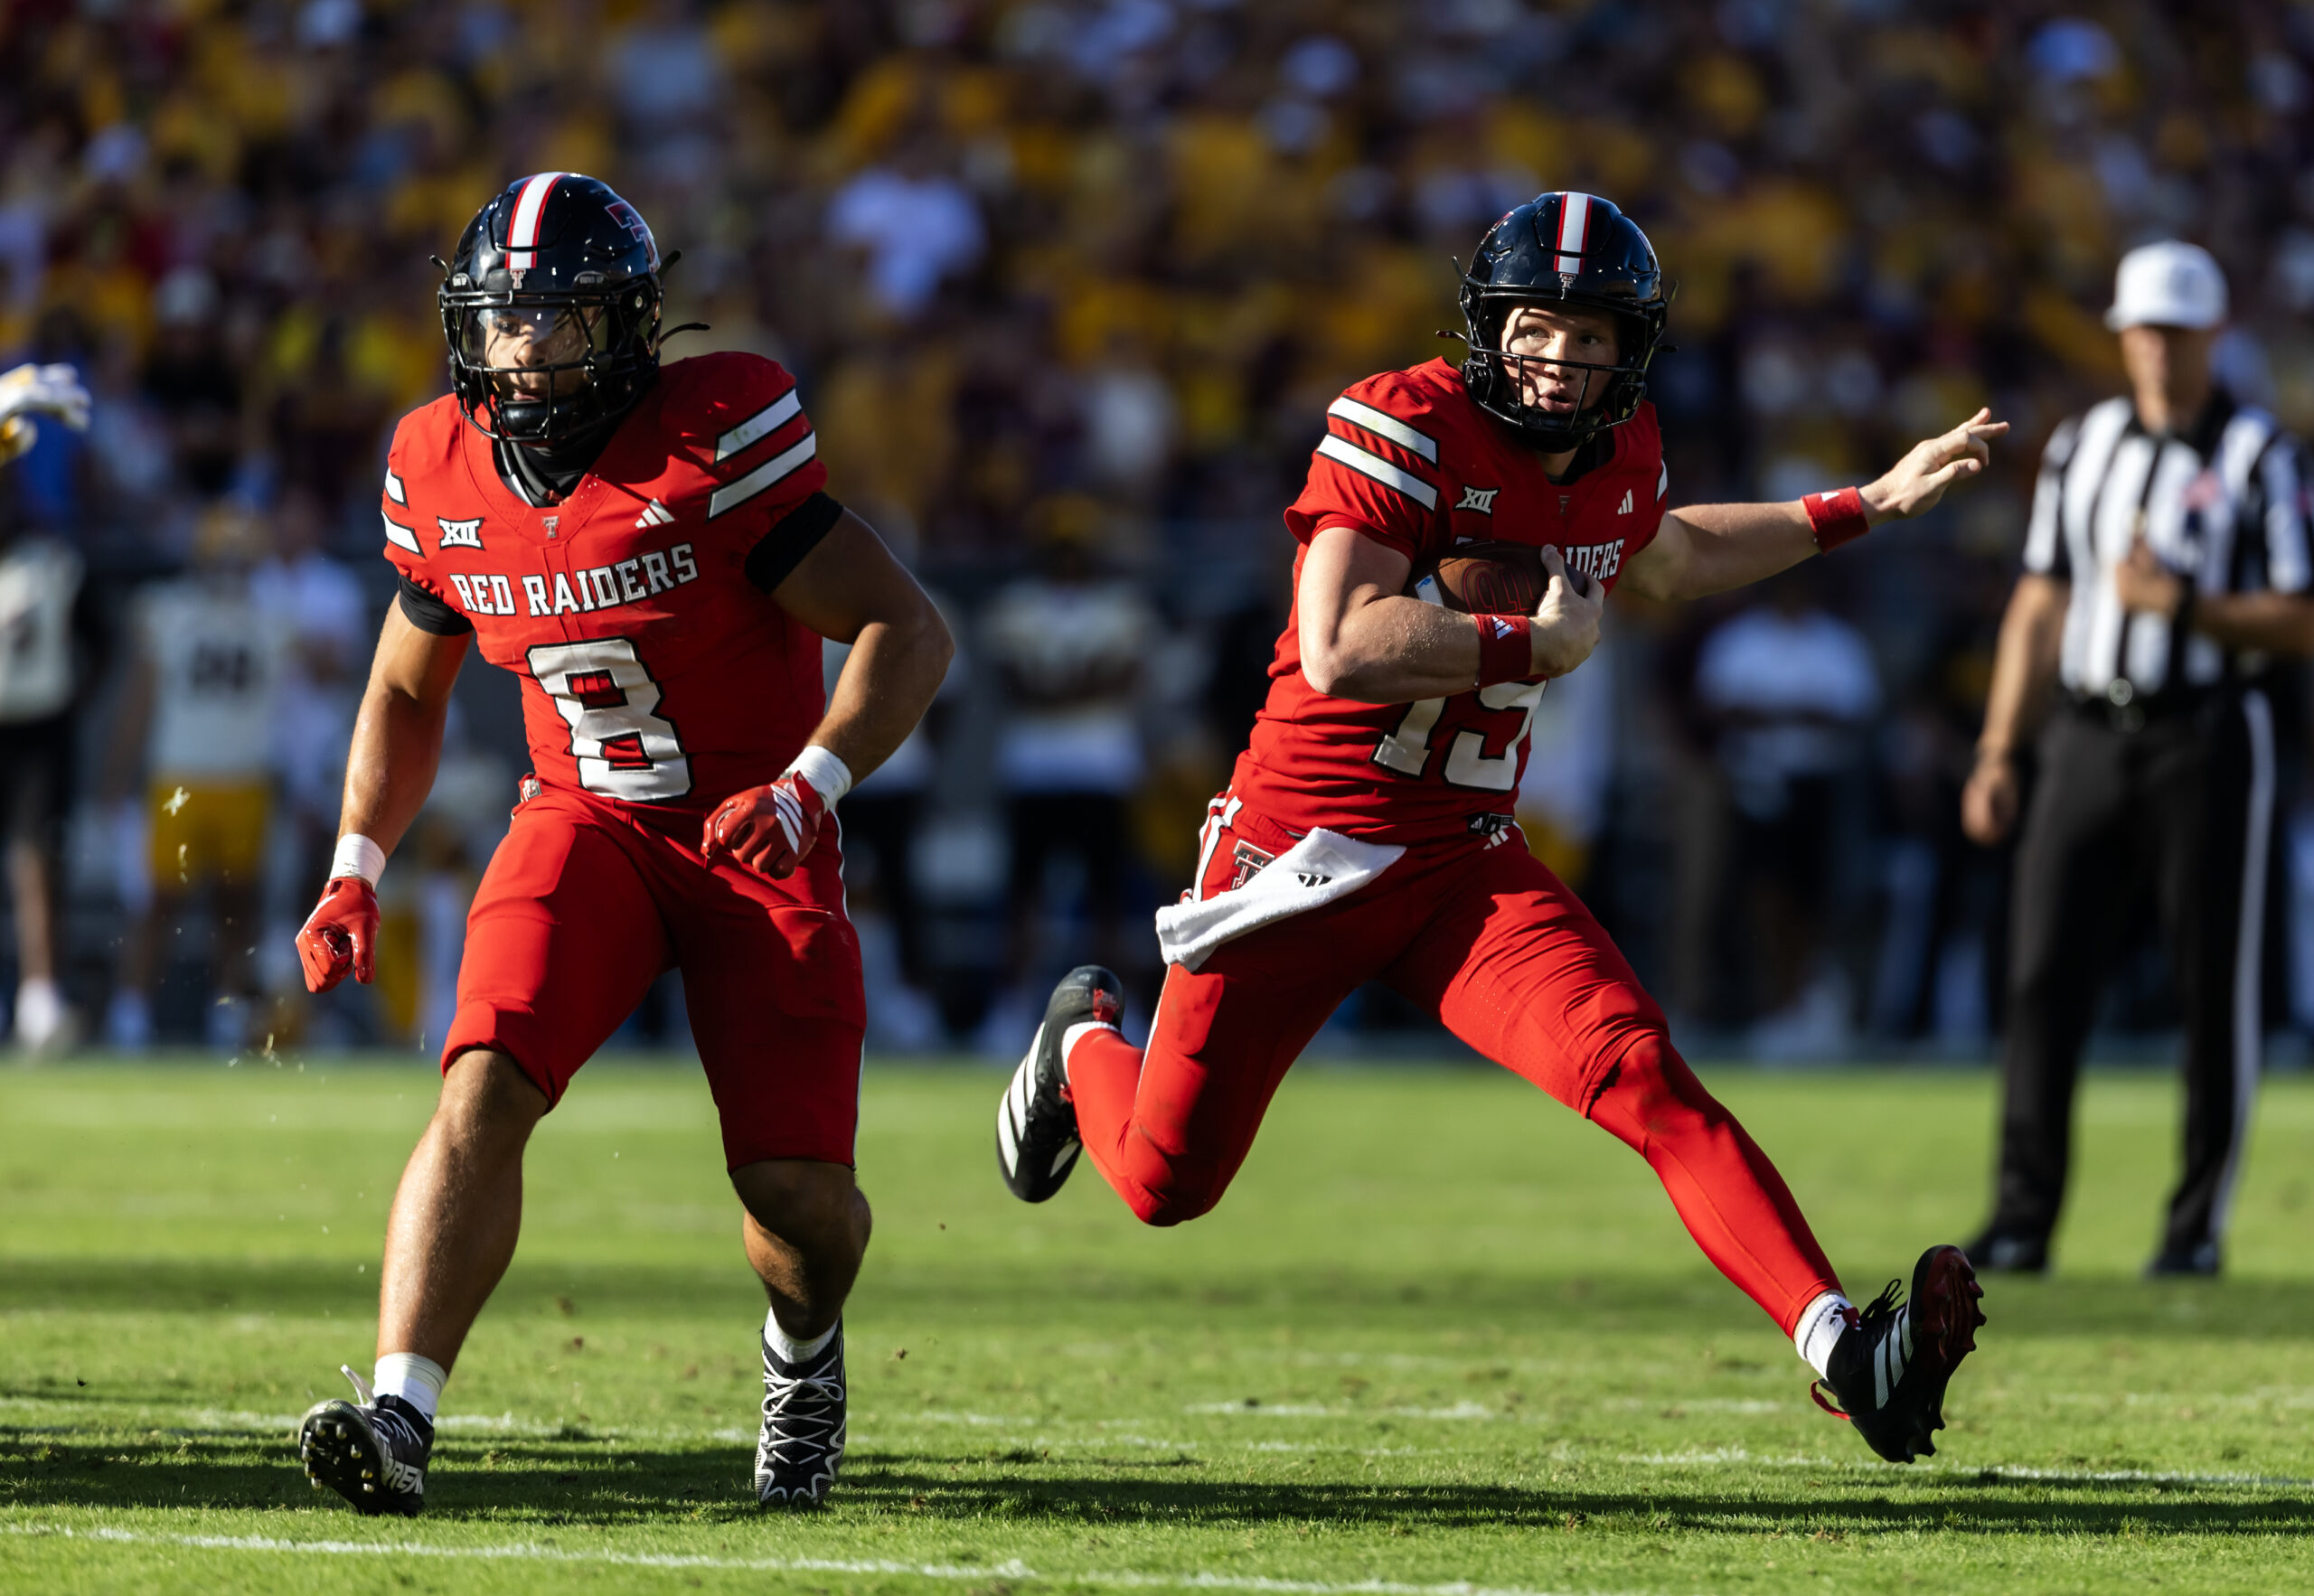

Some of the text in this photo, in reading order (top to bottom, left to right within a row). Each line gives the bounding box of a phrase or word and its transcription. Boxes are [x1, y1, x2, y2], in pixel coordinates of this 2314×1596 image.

[1453, 485, 1500, 516] XII
[437, 515, 485, 550] XII
[449, 542, 700, 617] RED RAIDERS
[1565, 537, 1625, 581] IDERS
[526, 635, 696, 803] 8
